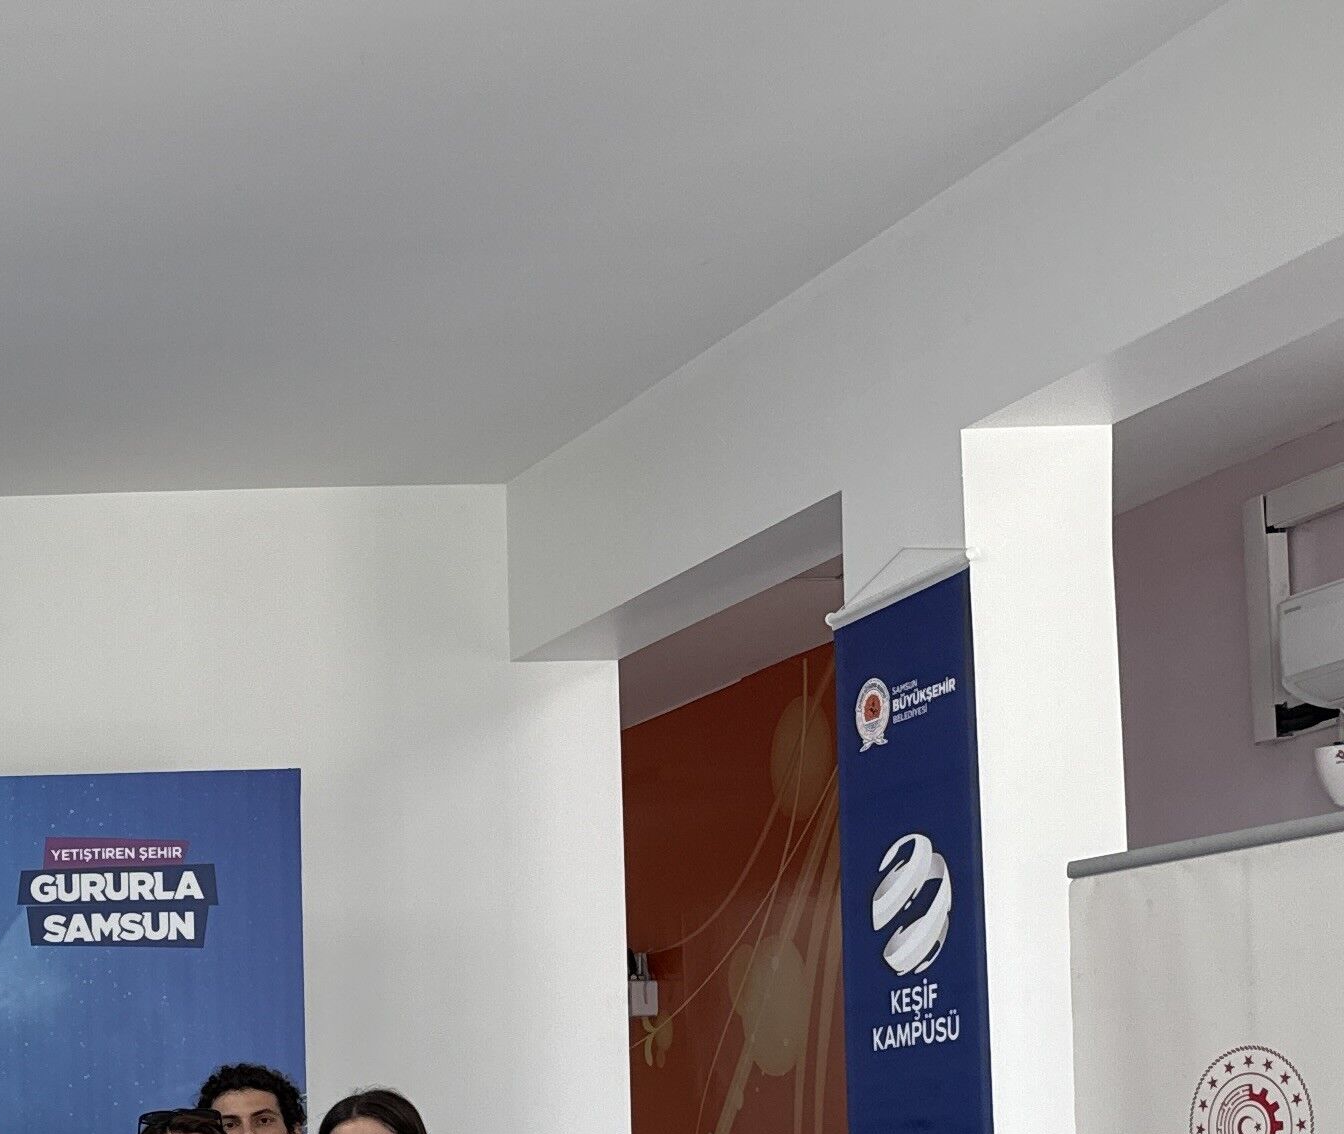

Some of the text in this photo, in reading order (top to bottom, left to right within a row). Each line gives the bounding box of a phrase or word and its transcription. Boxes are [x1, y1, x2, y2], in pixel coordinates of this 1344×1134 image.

[892, 676, 956, 712] BÜYÜKŞEHİR
[30, 871, 205, 902] GURURLA
[43, 911, 195, 942] SAMSUN
[890, 978, 938, 1020] KEŞİF
[872, 1009, 960, 1051] KAMPÜSÜ
